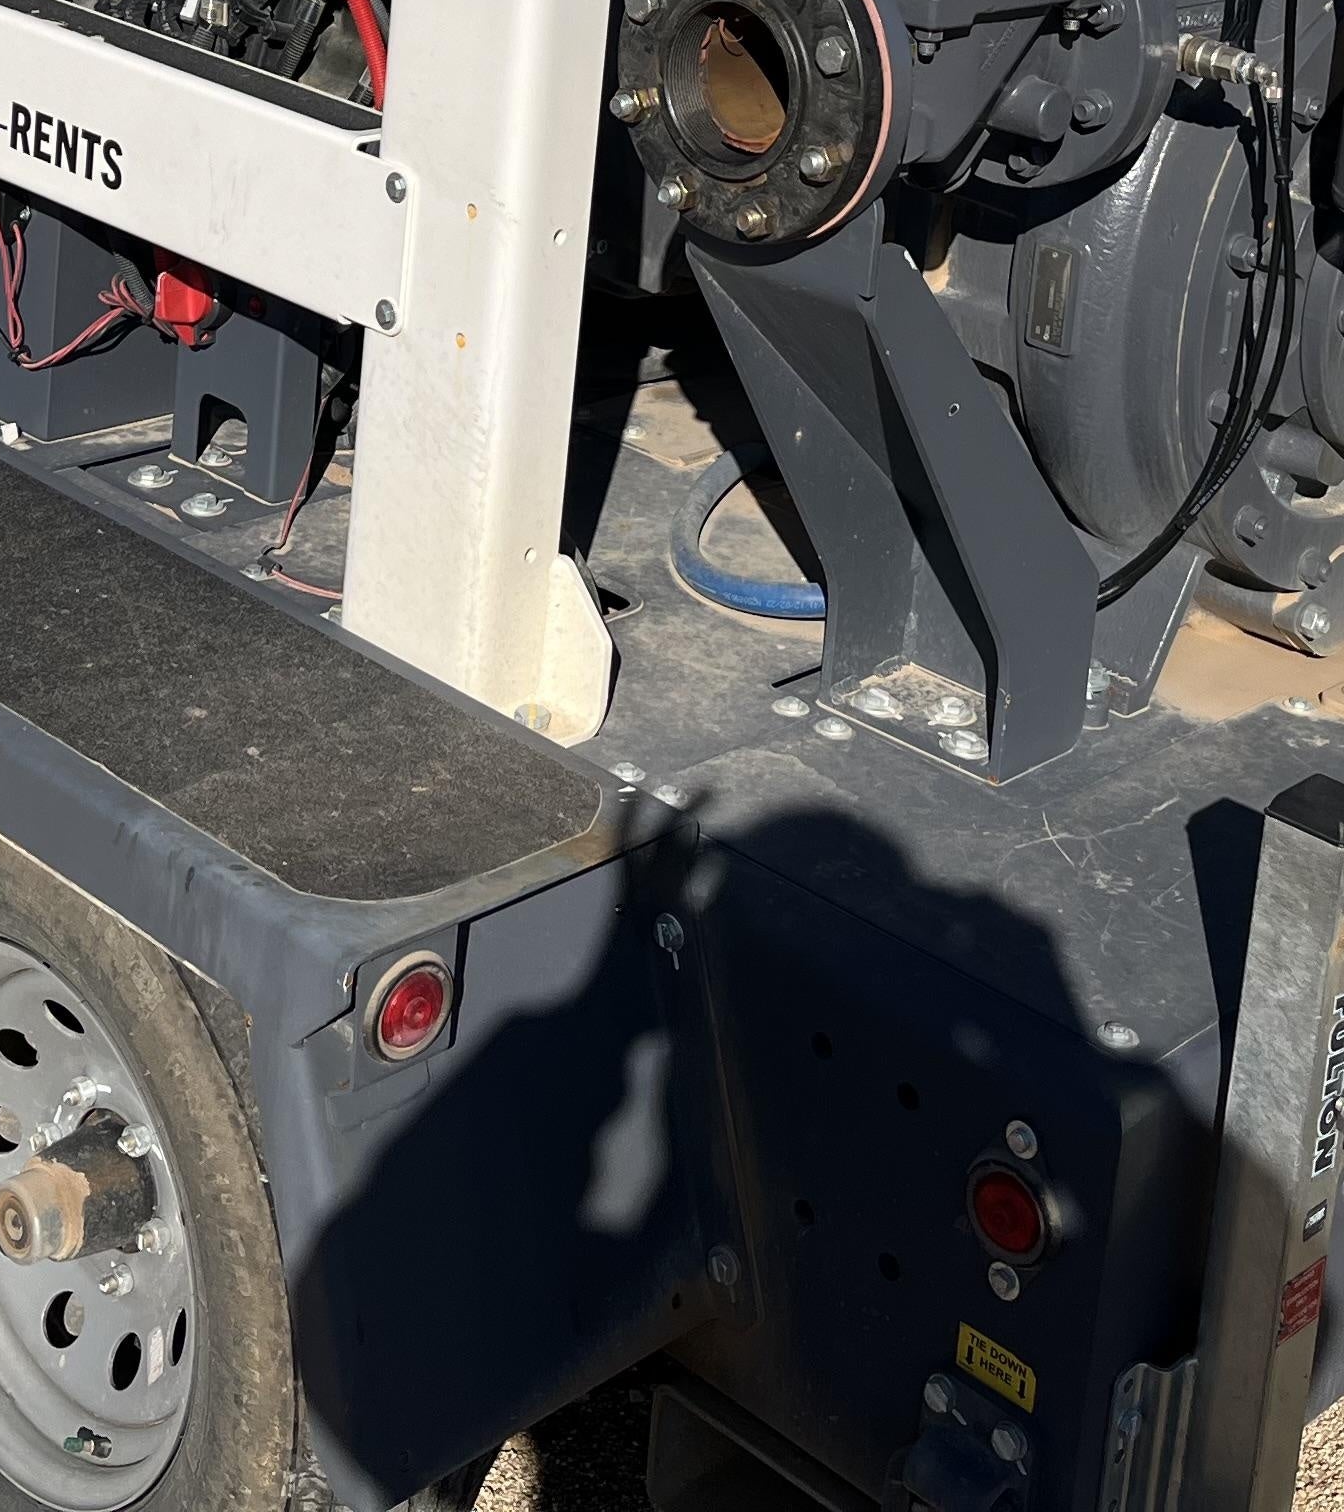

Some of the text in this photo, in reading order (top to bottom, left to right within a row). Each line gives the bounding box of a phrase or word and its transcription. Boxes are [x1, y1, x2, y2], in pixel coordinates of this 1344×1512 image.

[969, 1333, 1027, 1379] TIE DOWN
[979, 1356, 1012, 1386] HERE
